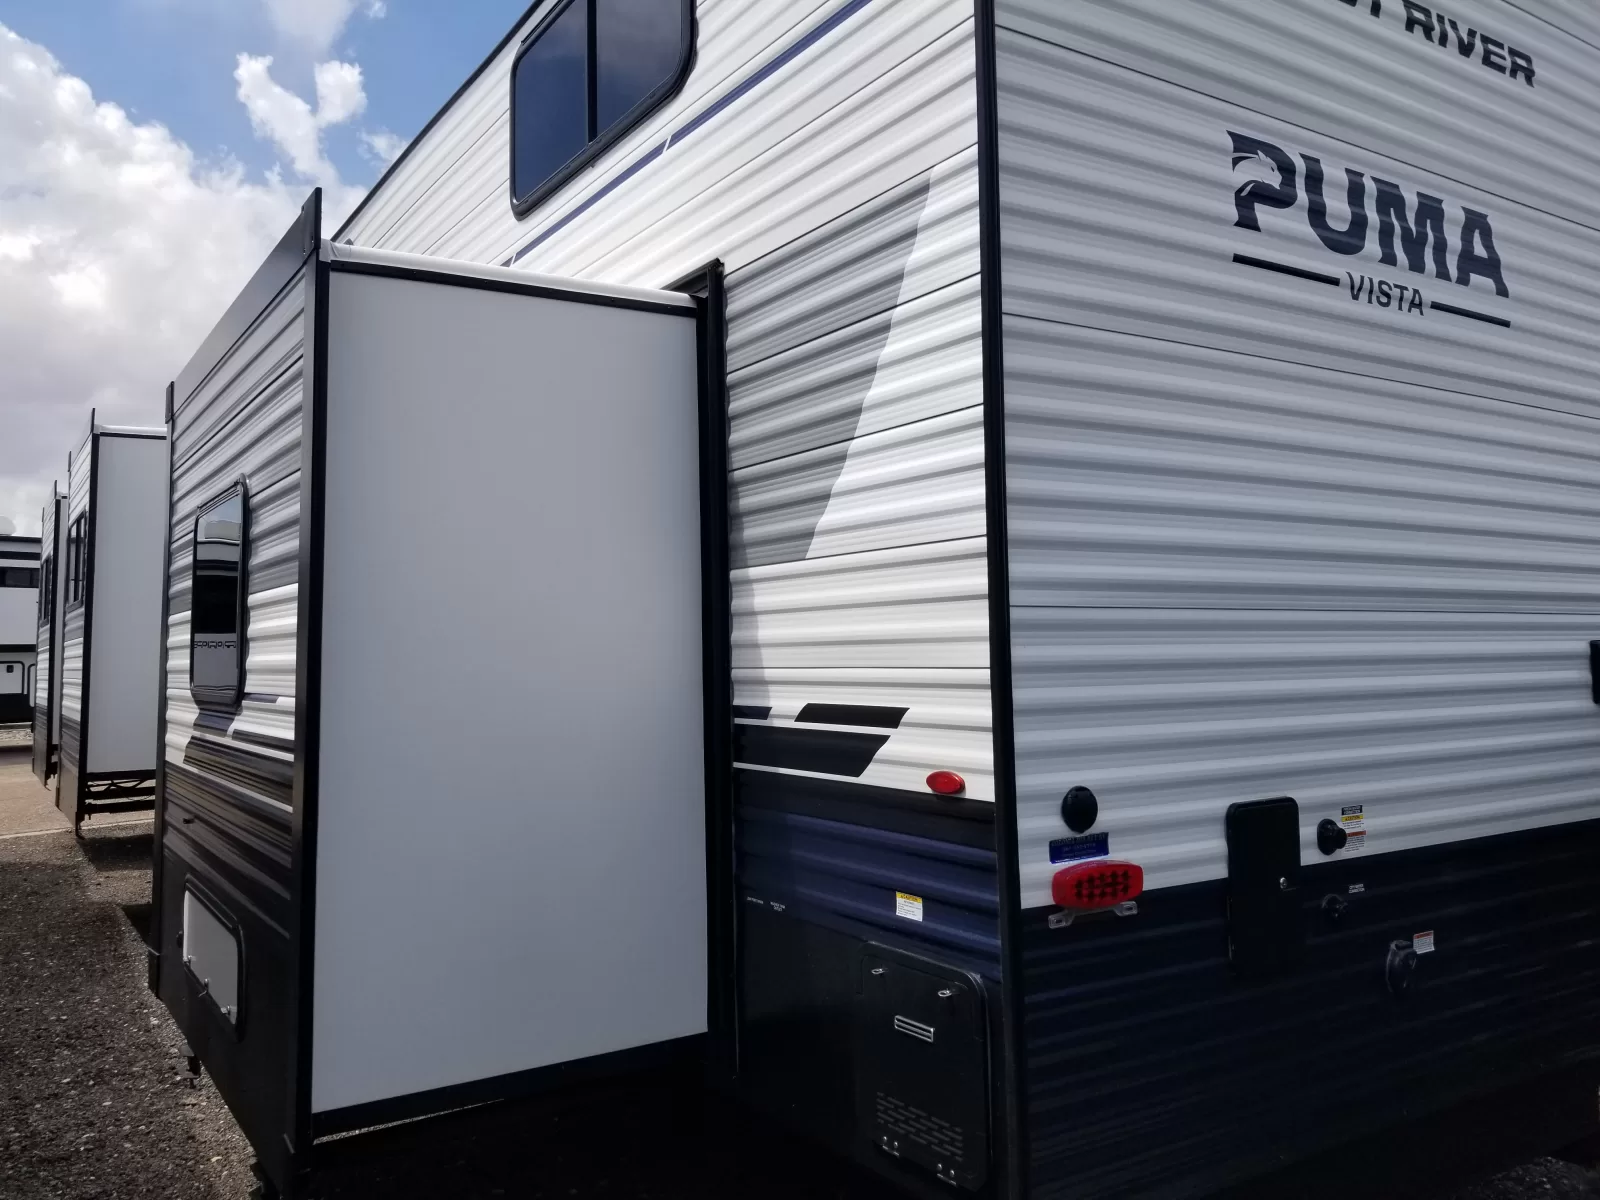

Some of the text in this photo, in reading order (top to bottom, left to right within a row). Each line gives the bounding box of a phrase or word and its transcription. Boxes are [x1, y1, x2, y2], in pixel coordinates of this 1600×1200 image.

[1403, 1, 1536, 88] RIVER
[1226, 129, 1510, 299] PUMA
[1346, 271, 1424, 316] VISTA
